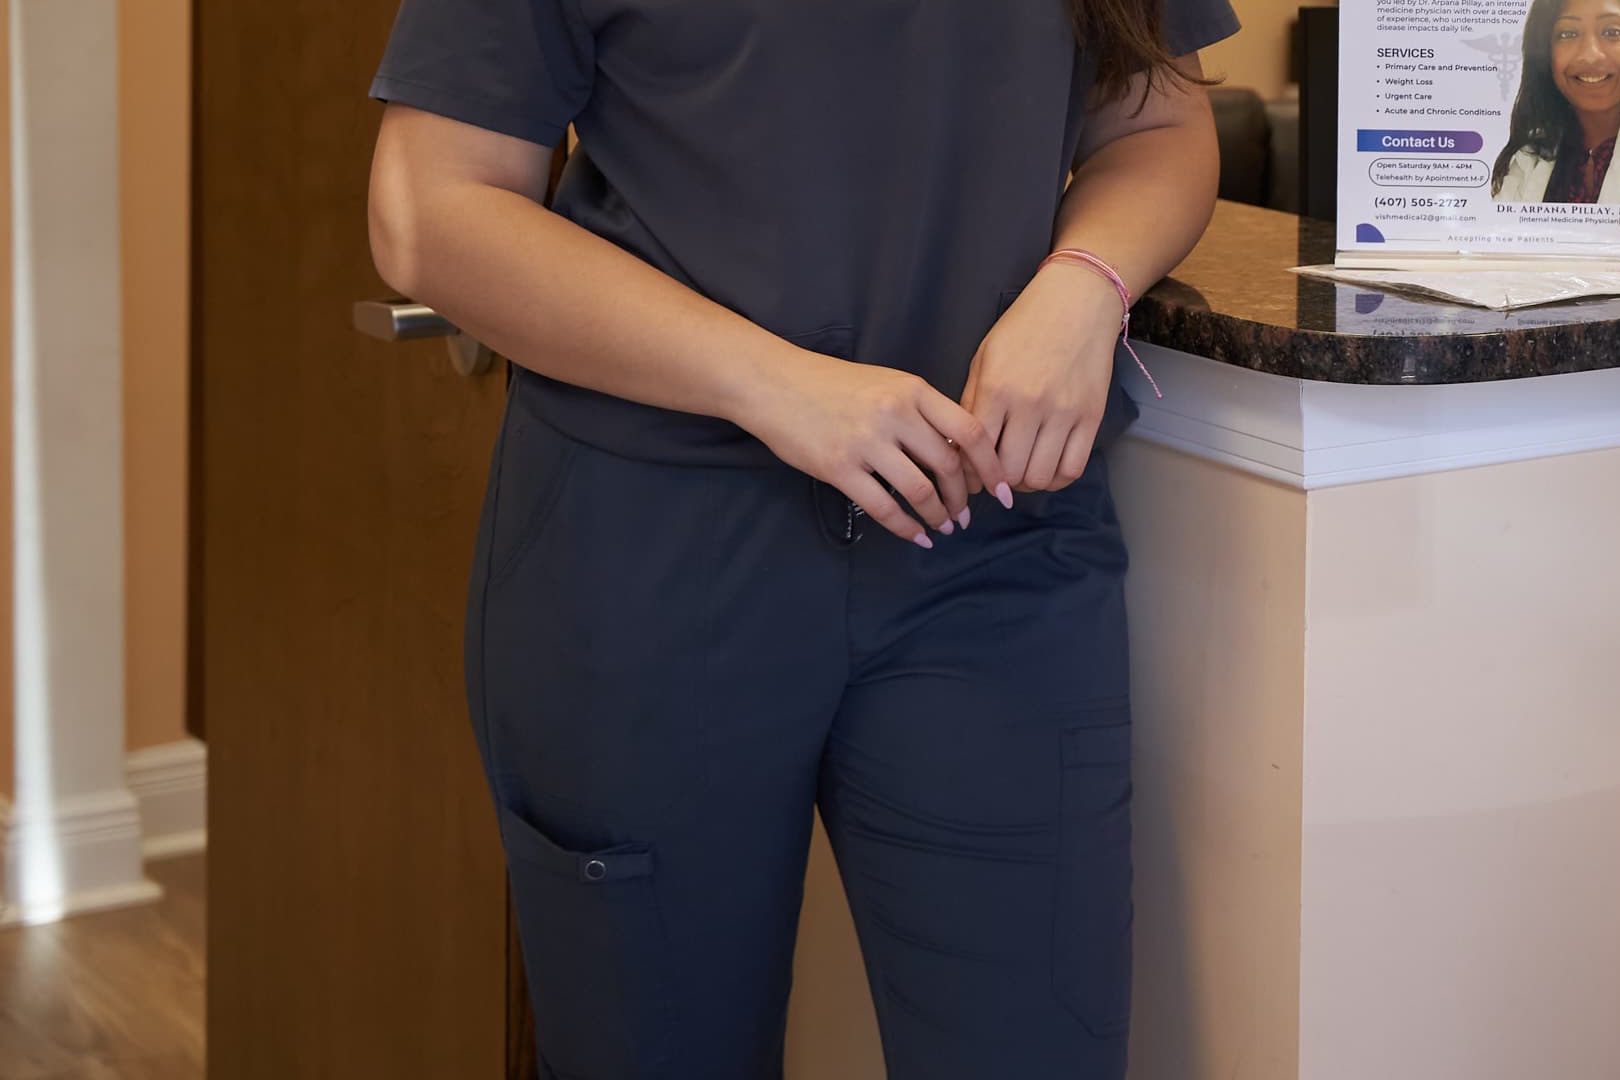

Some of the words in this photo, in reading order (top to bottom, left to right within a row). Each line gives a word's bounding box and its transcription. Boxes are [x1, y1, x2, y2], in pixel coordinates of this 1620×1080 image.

[1431, 0, 1460, 7] Arpana
[1461, 0, 1484, 8] Pillay,
[1496, 0, 1527, 8] internal
[1415, 7, 1451, 16] physician
[1386, 16, 1431, 24] experience,
[1450, 16, 1501, 24] understands
[1501, 17, 1520, 25] how
[1376, 23, 1406, 31] disease
[1407, 24, 1439, 33] impacts
[1440, 24, 1459, 34] daily
[1377, 48, 1435, 59] SERVICES
[1385, 63, 1416, 72] Primary
[1417, 63, 1436, 71] Care
[1437, 64, 1453, 72] and
[1454, 64, 1498, 72] Prevention
[1384, 78, 1413, 86] Weight
[1415, 78, 1433, 86] Loss
[1385, 92, 1412, 101] Urgent
[1384, 107, 1407, 115] Acute
[1409, 107, 1425, 115] and
[1426, 108, 1457, 116] Chronic
[1458, 108, 1502, 116] Conditions
[1382, 135, 1435, 148] Contact
[1438, 136, 1456, 149] Us
[1376, 162, 1397, 170] Open
[1398, 162, 1431, 171] Saturday
[1375, 173, 1413, 181] Telehealth
[1414, 174, 1424, 183] by
[1425, 174, 1469, 183] Apointment
[1374, 197, 1407, 209] (407)
[1411, 198, 1468, 208] 505-2727
[1496, 204, 1516, 213] DR.
[1520, 204, 1567, 214] ARPANA
[1571, 205, 1615, 216] PILLAY,
[1519, 215, 1550, 224] (Internal
[1550, 216, 1583, 224] Medicine
[1448, 234, 1492, 243] Accepting
[1517, 236, 1555, 244] Patients
